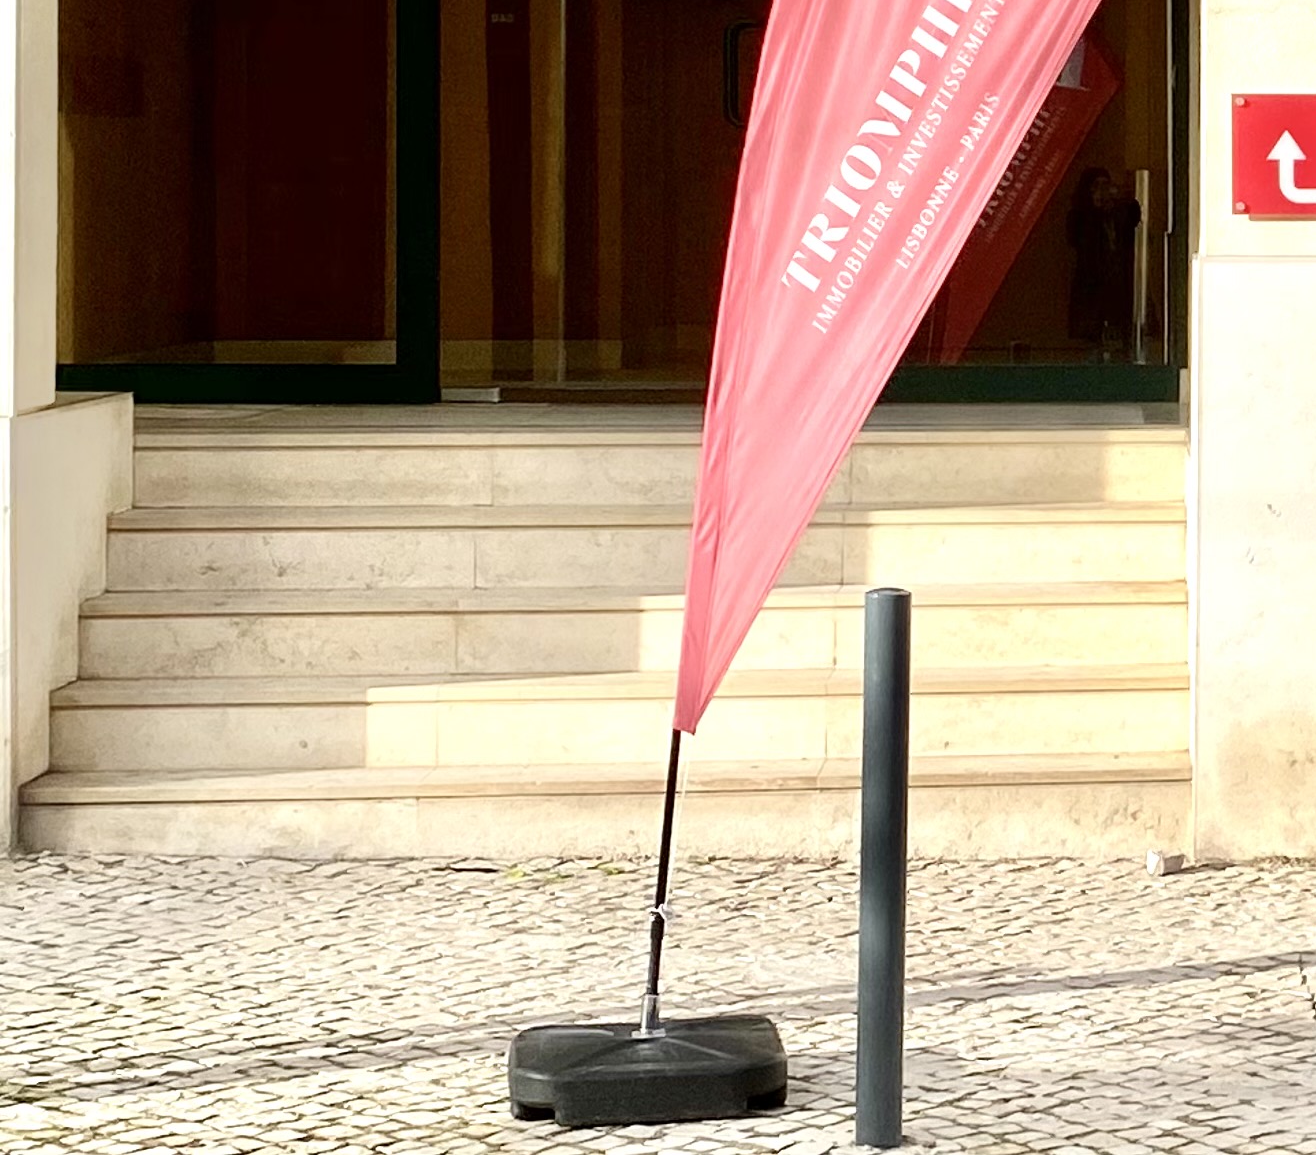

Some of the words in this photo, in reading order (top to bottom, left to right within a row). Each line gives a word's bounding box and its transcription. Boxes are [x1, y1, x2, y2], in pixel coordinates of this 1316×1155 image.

[811, 200, 894, 334] IMMOBILIER
[886, 180, 906, 199] &
[895, 165, 960, 270] LISBONNE
[959, 92, 1000, 151] PARIS
